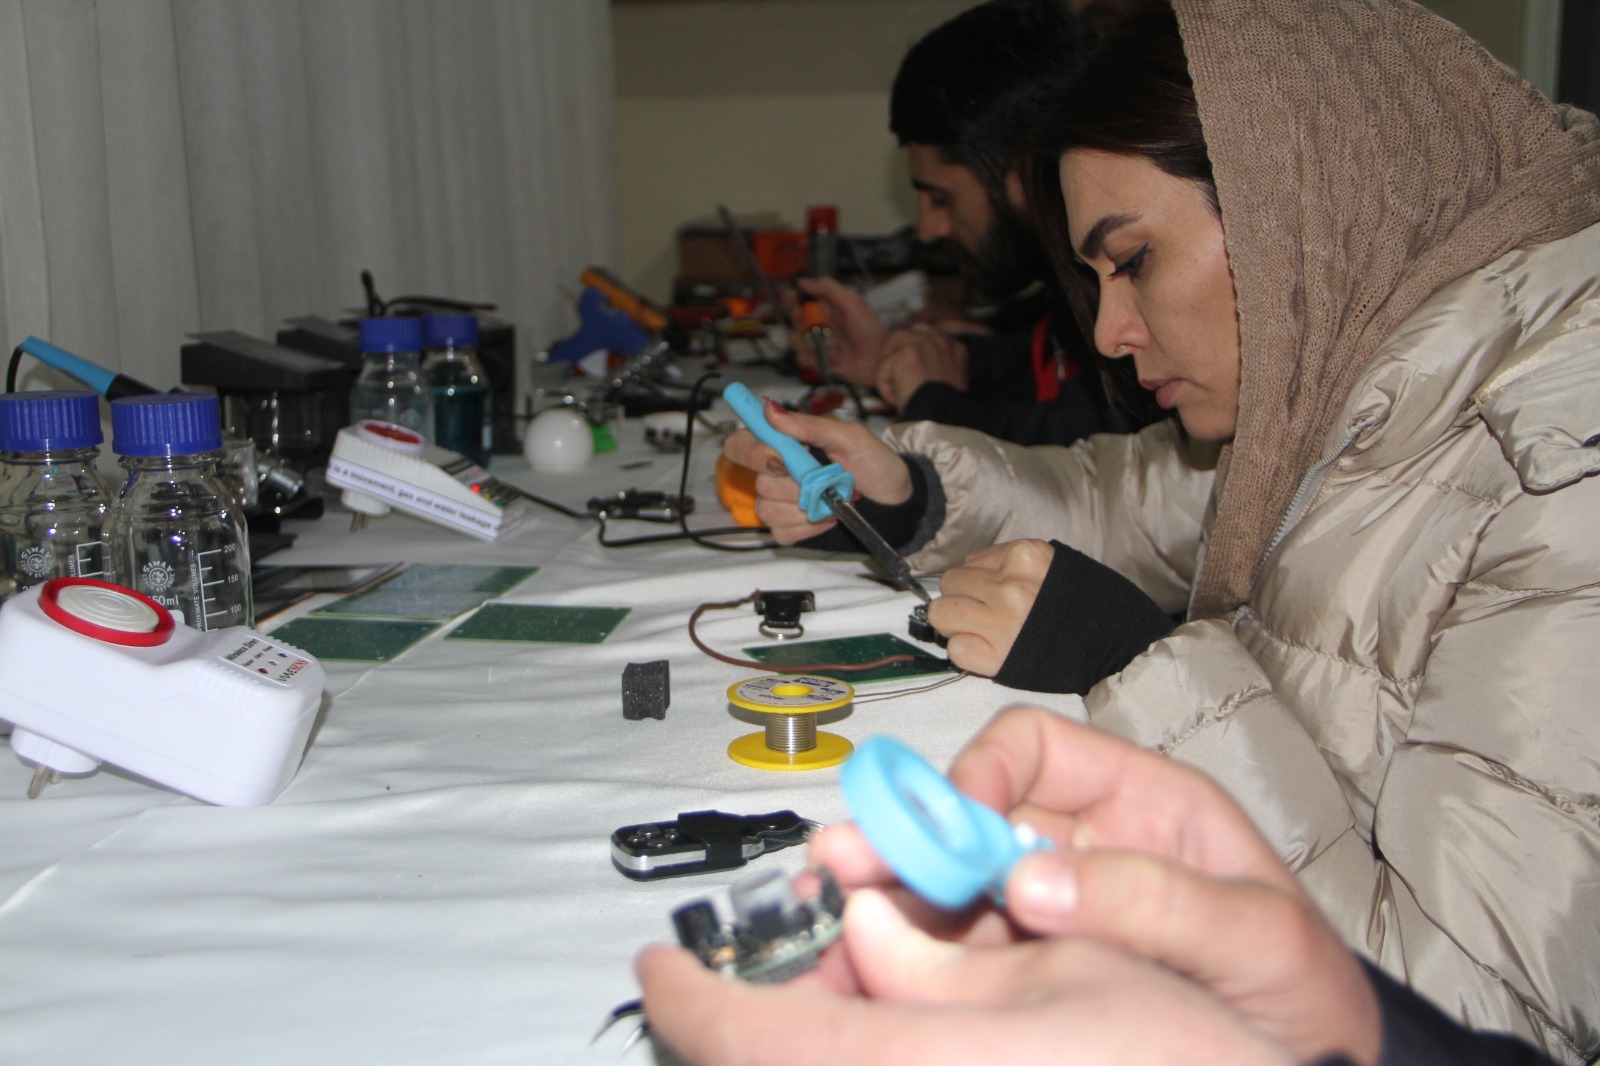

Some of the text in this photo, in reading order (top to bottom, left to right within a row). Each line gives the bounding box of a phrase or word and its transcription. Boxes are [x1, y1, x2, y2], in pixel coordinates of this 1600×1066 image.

[415, 494, 433, 506] and
[434, 502, 458, 516] water
[458, 510, 493, 529] leakage
[21, 546, 51, 559] SIMAX
[223, 543, 236, 553] 200
[143, 560, 173, 573] SIMAX
[190, 563, 199, 594] VOLUMES
[227, 573, 239, 584] 150
[148, 594, 179, 606] 50ml
[230, 603, 242, 614] 100
[225, 645, 248, 661] Wireless
[243, 638, 259, 649] Siren
